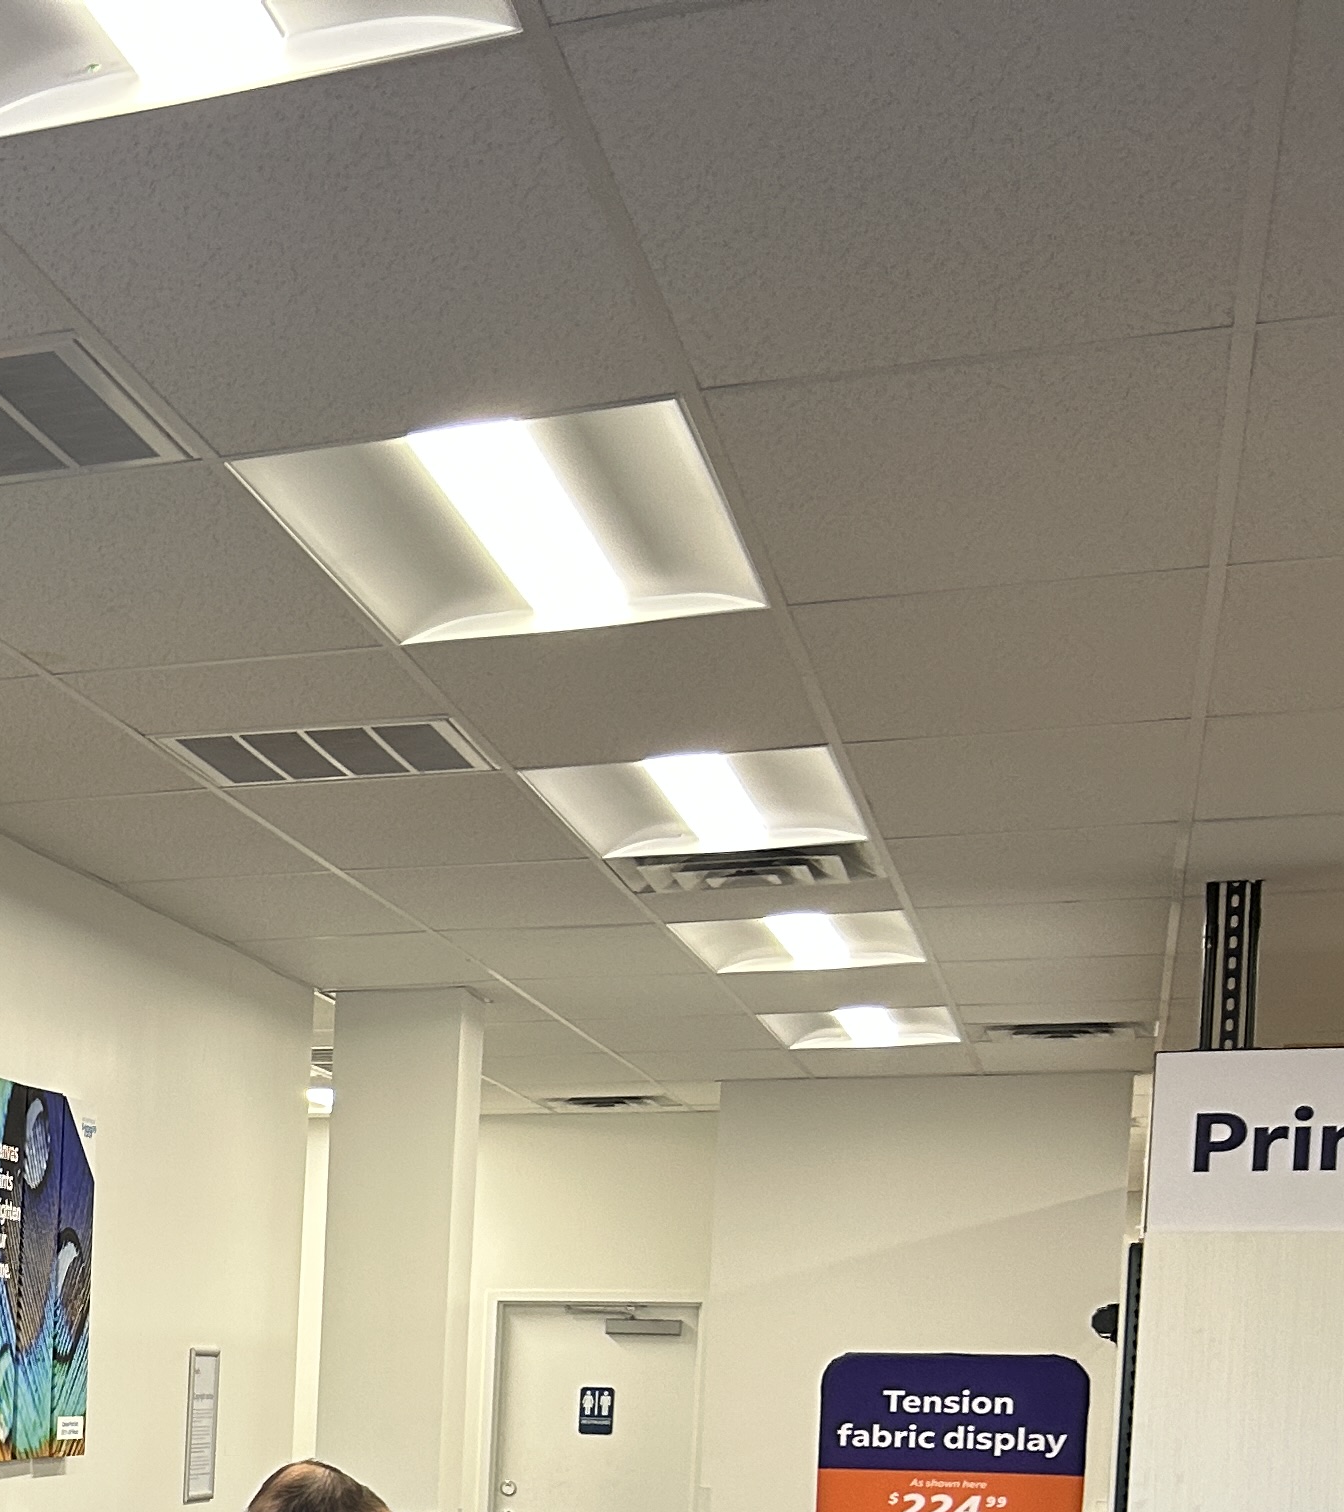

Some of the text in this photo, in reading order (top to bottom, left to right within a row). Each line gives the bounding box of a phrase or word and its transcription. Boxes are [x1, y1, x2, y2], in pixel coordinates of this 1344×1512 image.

[883, 1389, 1014, 1415] Tension
[836, 1423, 1068, 1458] fabric display
[910, 1478, 987, 1489] As shown here
